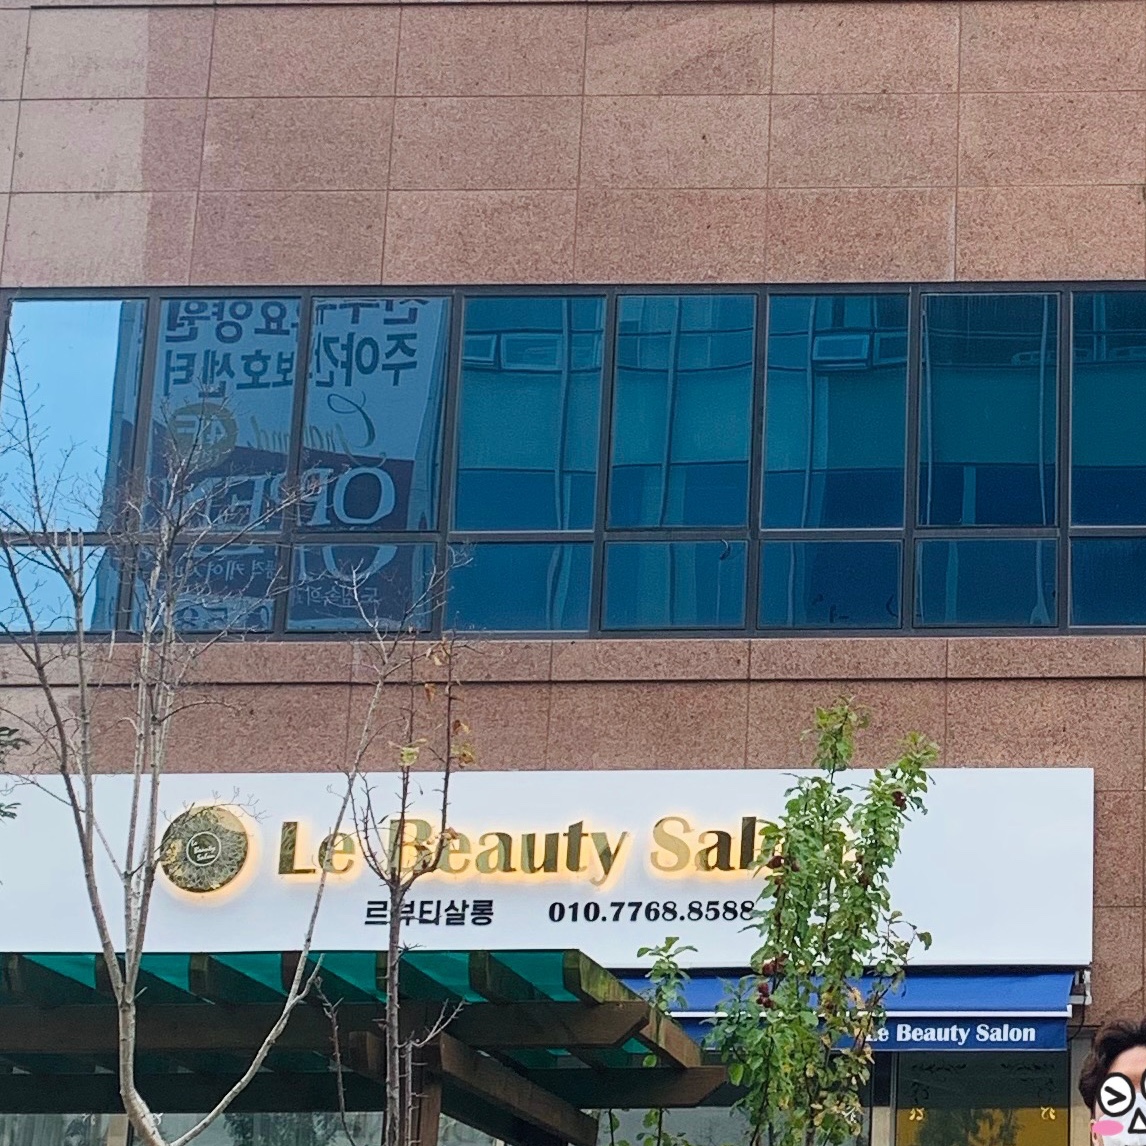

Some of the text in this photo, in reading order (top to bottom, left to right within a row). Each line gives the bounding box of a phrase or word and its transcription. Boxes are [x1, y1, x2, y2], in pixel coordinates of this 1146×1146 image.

[278, 821, 355, 876] Le
[386, 817, 629, 886] Beauty
[548, 900, 755, 922] 010.7768.8588
[896, 1024, 970, 1046] Beauty
[976, 1024, 1036, 1042] Salon
